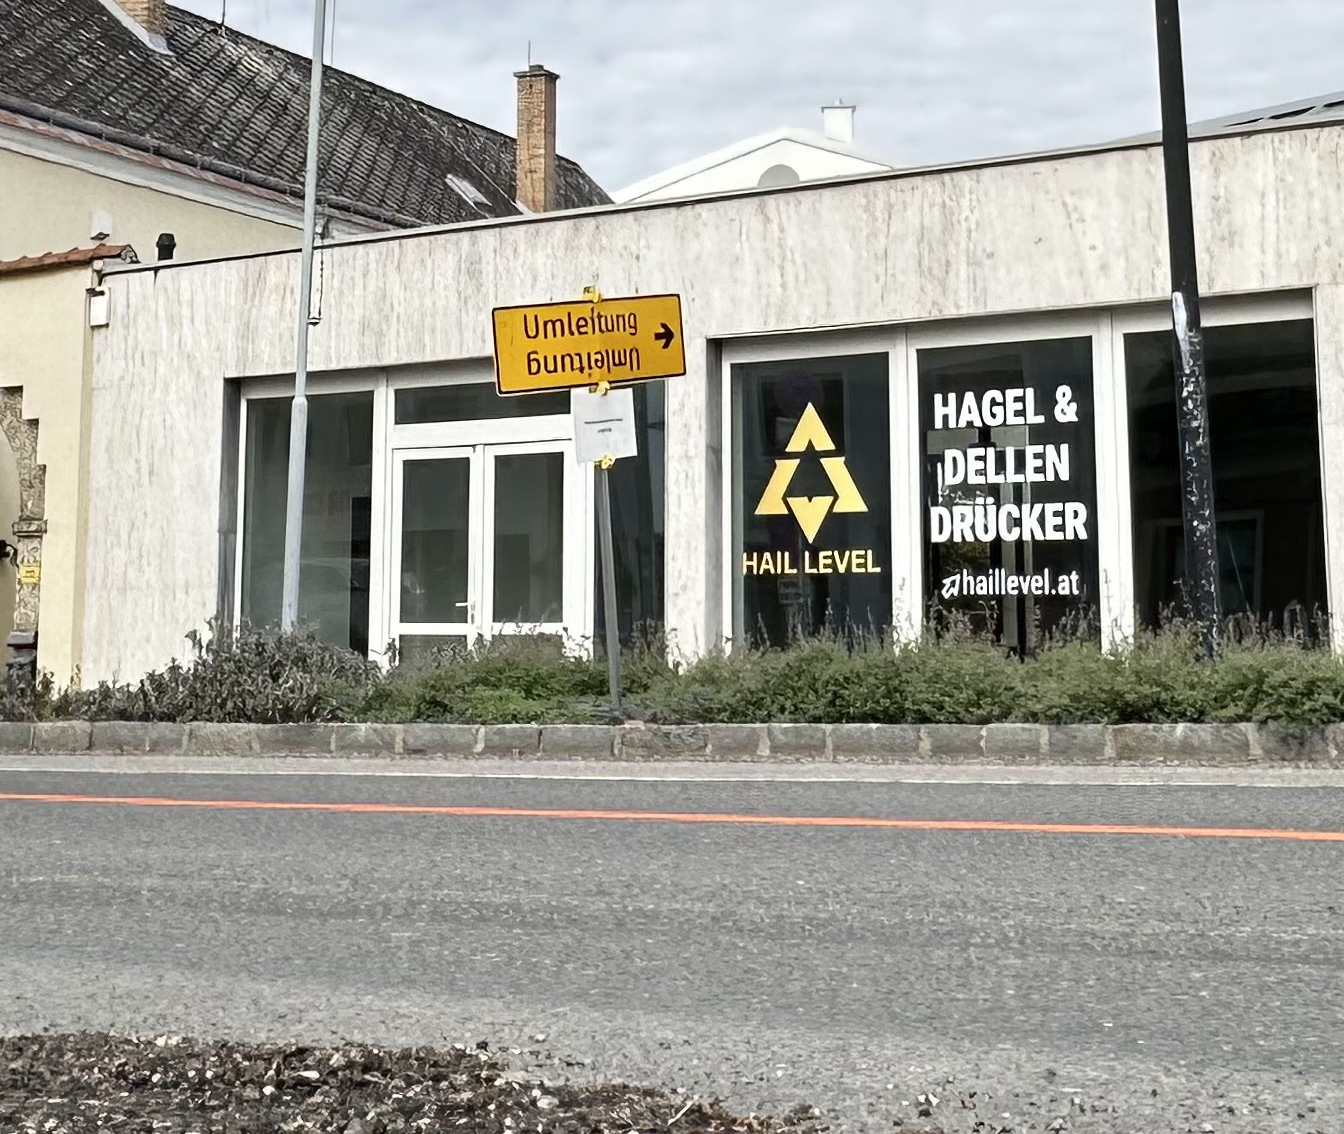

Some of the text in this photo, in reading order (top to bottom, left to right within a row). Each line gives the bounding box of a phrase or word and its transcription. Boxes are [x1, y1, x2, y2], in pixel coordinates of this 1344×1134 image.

[523, 307, 638, 340] Umleitung
[527, 347, 641, 379] Umleitung
[933, 384, 1079, 429] HAGEL &
[943, 443, 1070, 486] DELLEN
[929, 497, 1089, 543] DRÜCKER
[742, 549, 882, 576] HAIL LEVEL
[962, 568, 1080, 596] haillevel.at
